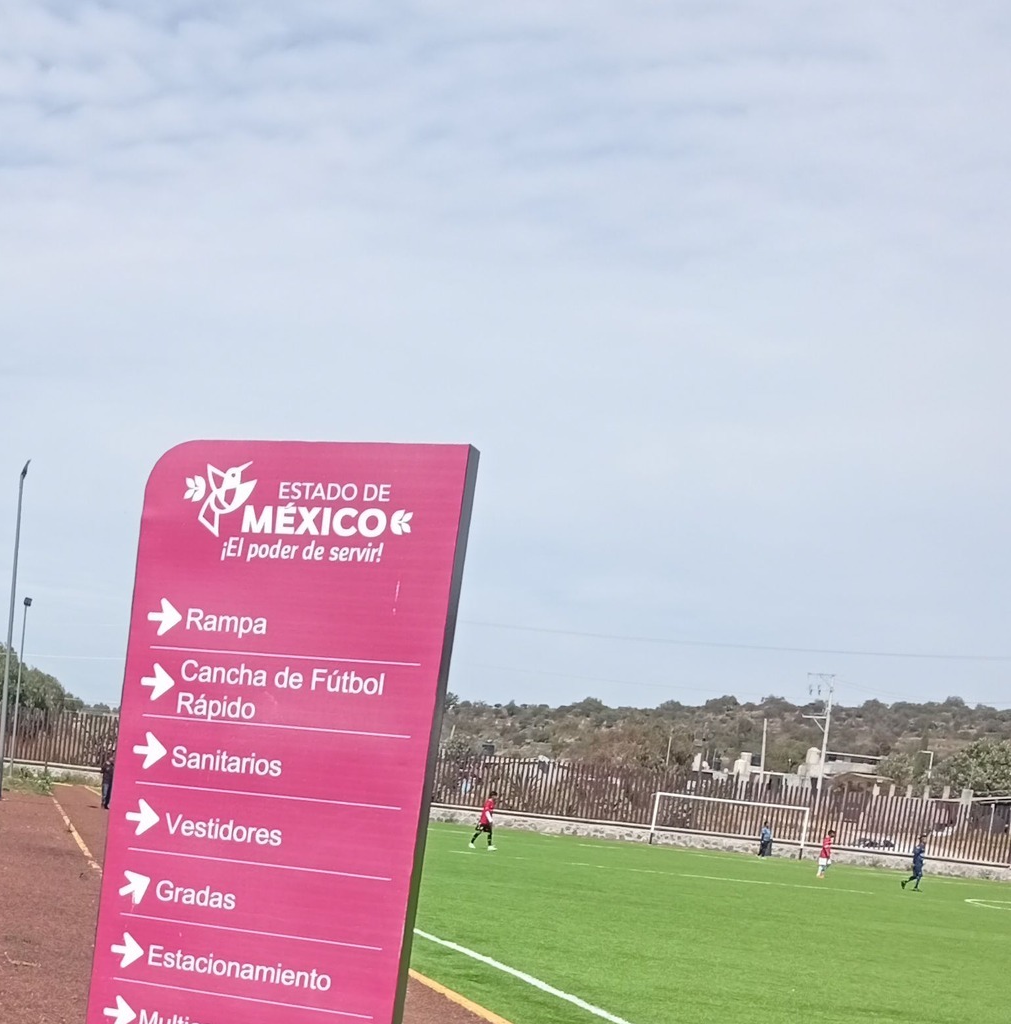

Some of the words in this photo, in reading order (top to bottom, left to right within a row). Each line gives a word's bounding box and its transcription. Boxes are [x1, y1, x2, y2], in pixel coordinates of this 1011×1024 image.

[278, 481, 358, 502] ESTADO
[362, 483, 392, 502] DE
[240, 502, 387, 538] MÉXICO
[220, 536, 244, 561] ¡El
[246, 538, 299, 562] poder
[301, 540, 324, 561] de
[328, 542, 384, 563] servir!
[185, 607, 268, 639] Rampa
[181, 659, 267, 687] Cancha
[274, 666, 304, 690] de
[310, 668, 386, 696] Fútbol
[176, 691, 256, 720] Rápido
[171, 745, 282, 777] Sanitarios
[165, 812, 282, 846] Vestidores
[155, 879, 236, 910] Gradas
[147, 944, 332, 992] Estacionamiento
